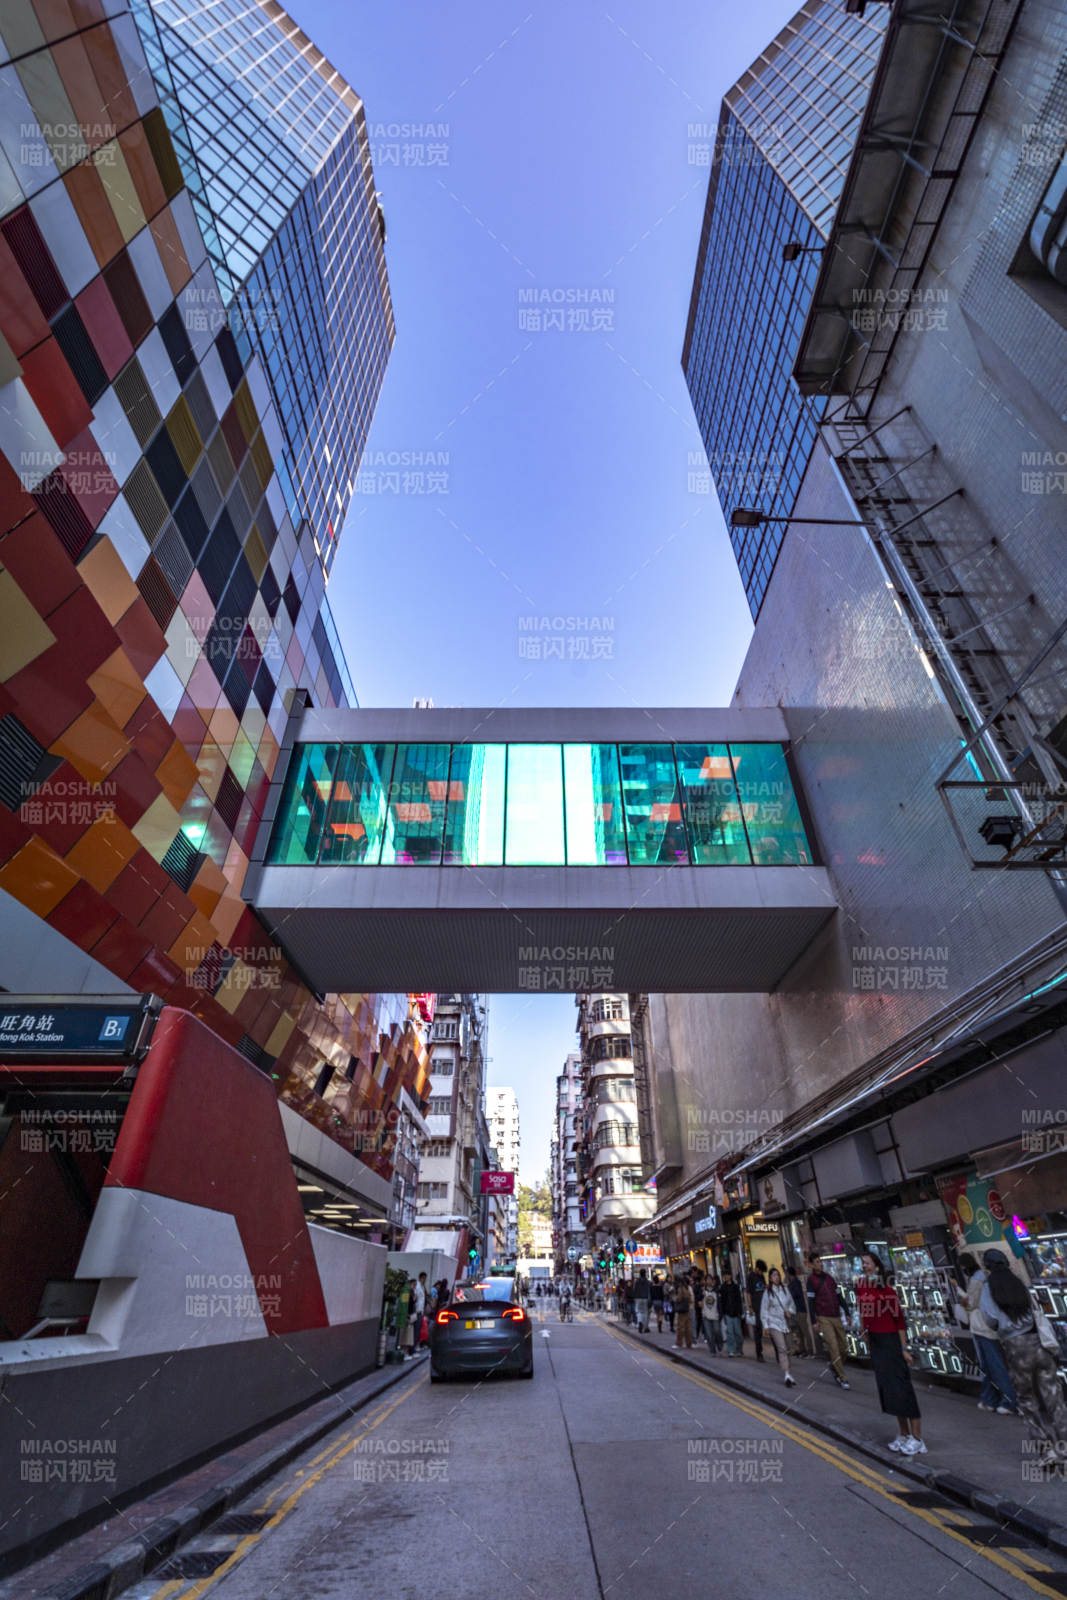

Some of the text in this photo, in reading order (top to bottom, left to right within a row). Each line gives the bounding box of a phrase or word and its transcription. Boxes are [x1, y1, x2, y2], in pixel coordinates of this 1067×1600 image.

[103, 1020, 122, 1037] B1
[19, 1033, 34, 1041] Kok
[35, 1033, 64, 1041] Station
